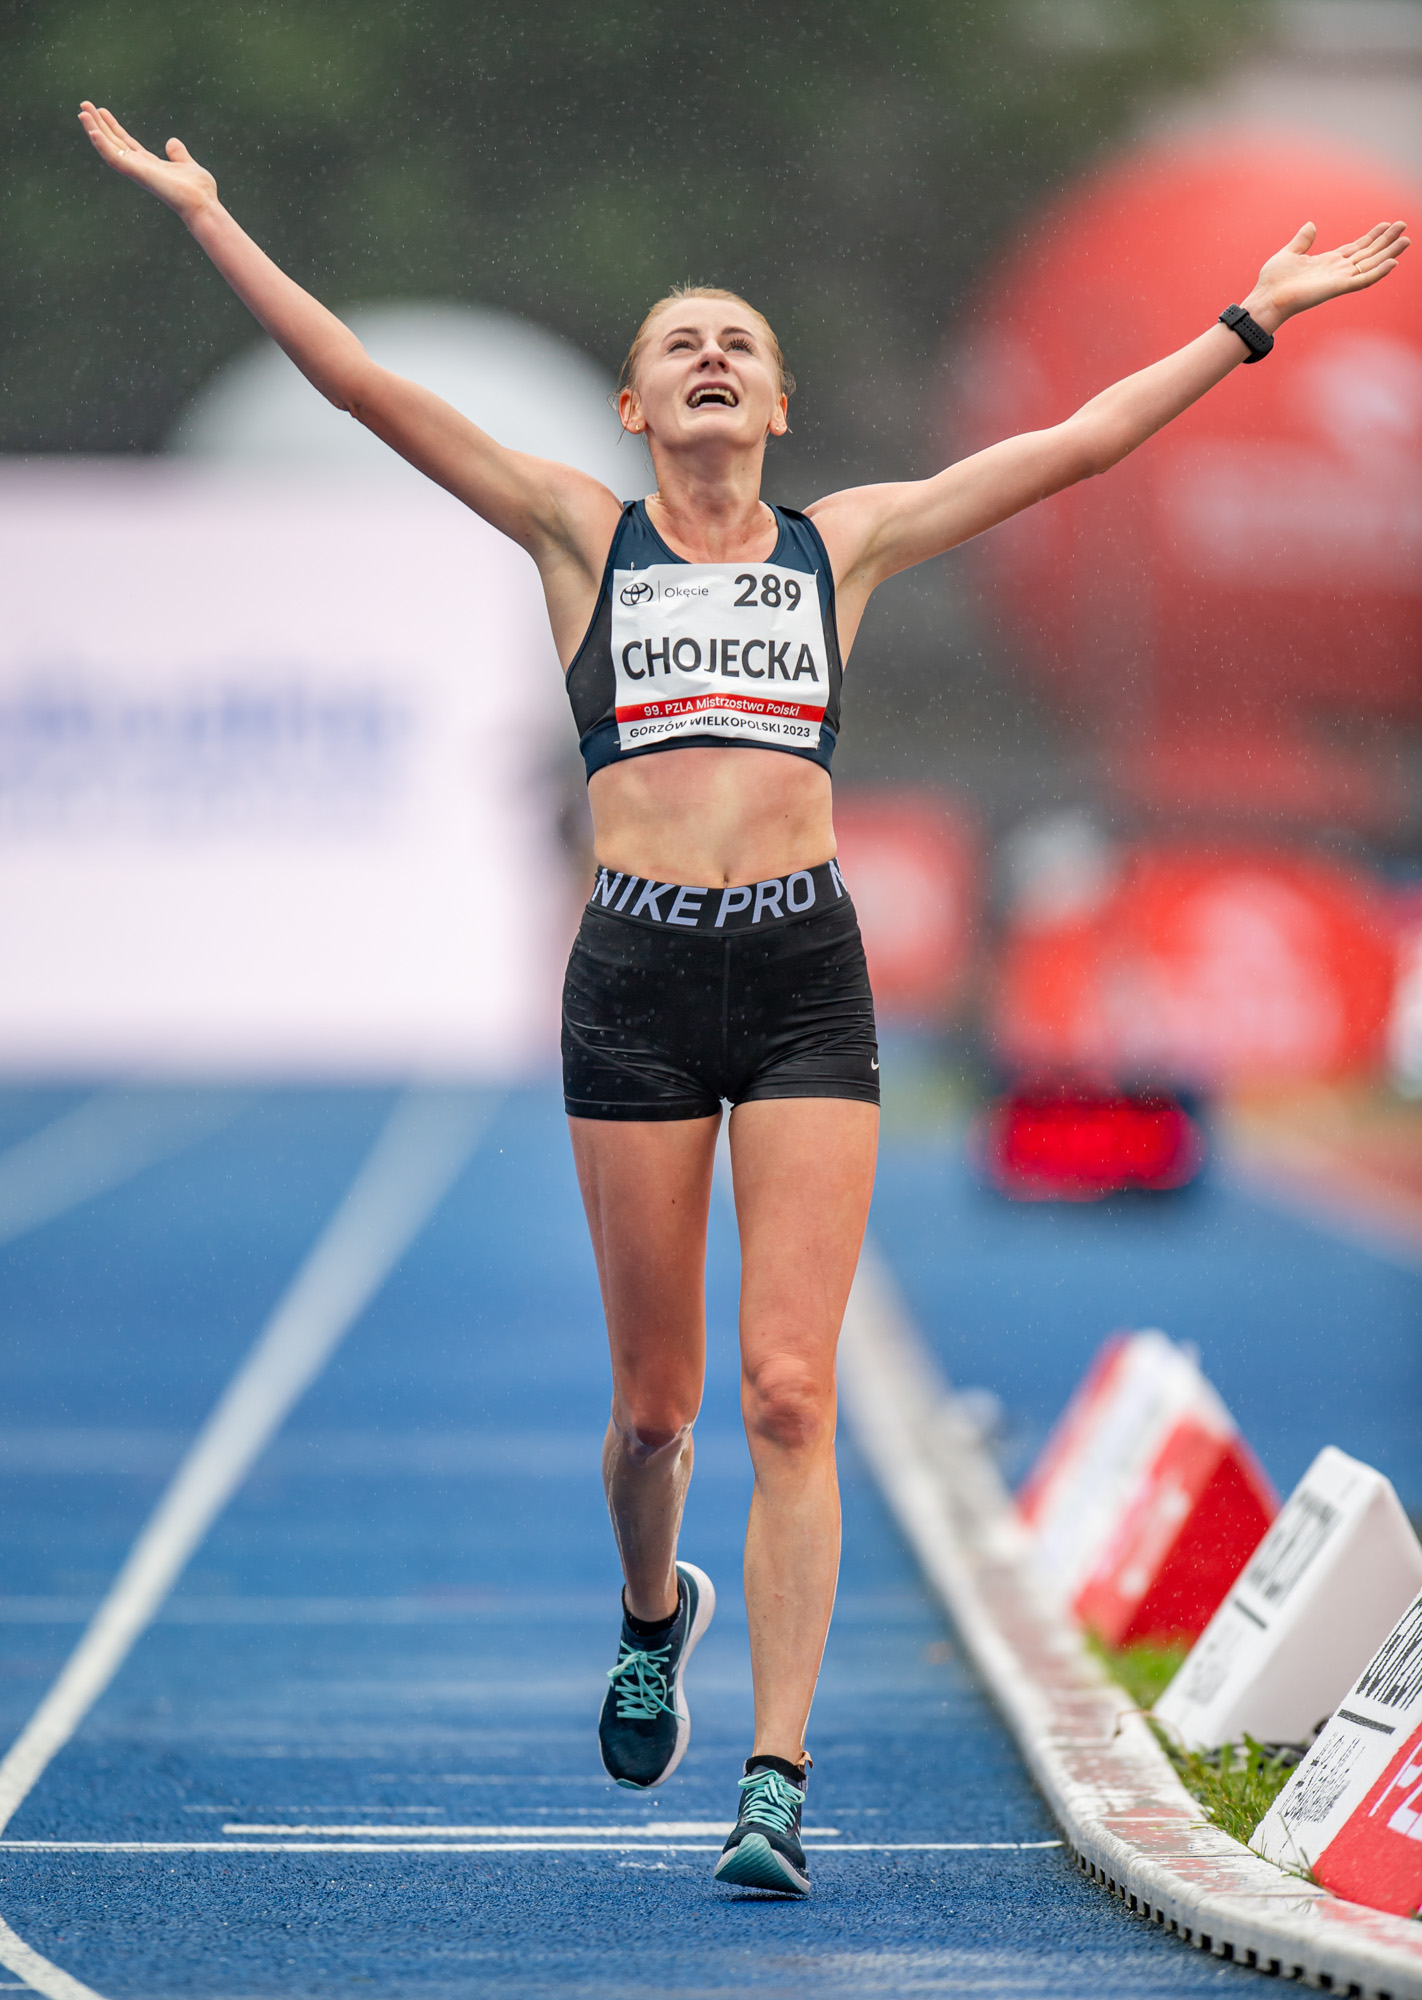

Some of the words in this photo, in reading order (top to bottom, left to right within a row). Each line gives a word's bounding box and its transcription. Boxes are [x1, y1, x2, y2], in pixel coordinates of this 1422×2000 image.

[664, 585, 709, 599] Okęcie
[733, 573, 801, 611] 289
[621, 636, 819, 682] CHOJECKA
[644, 705, 663, 717] 99.
[665, 702, 694, 715] PZLA
[696, 696, 764, 713] Mistrzostwa
[766, 703, 800, 717] Polski
[629, 719, 687, 738] GORZÓW
[690, 715, 781, 733] WIELKOPOLSKI
[783, 724, 811, 738] 2023
[591, 868, 708, 926] NIKE
[714, 870, 816, 928] PRO
